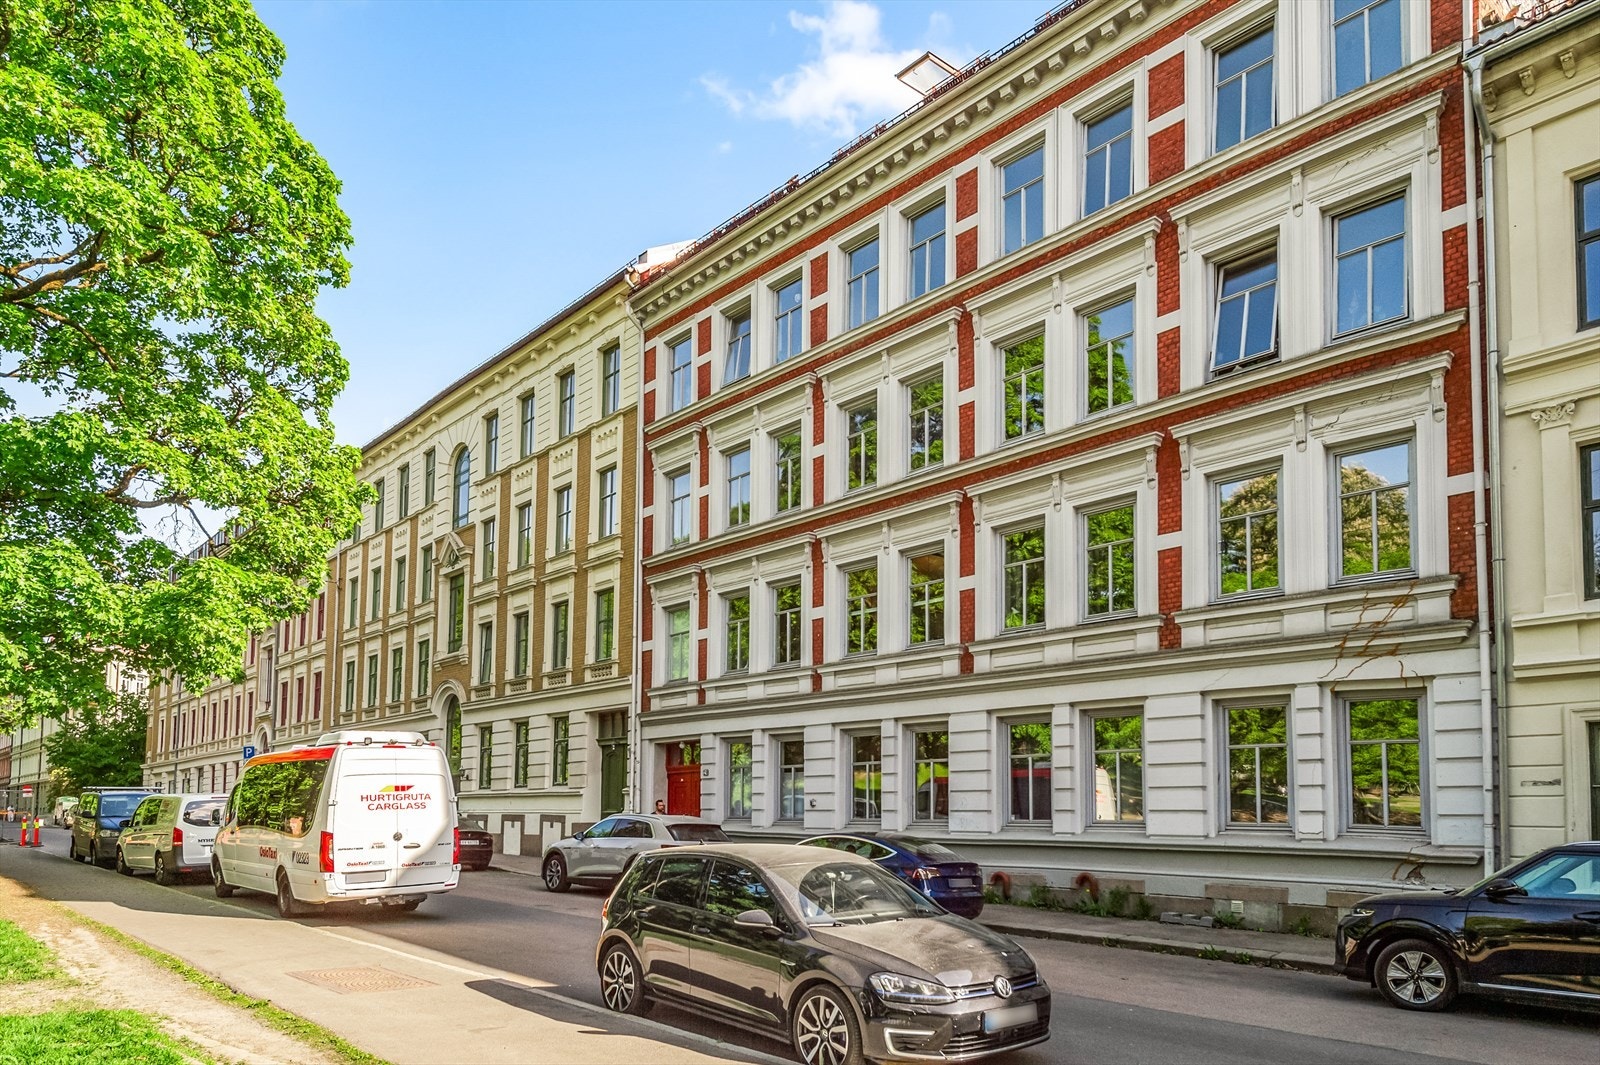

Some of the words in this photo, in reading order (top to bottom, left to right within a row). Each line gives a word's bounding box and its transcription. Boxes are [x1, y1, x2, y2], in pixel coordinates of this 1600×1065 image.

[246, 748, 252, 757] P
[361, 793, 431, 801] HURTIGRUTA
[368, 802, 427, 810] CARGLASS
